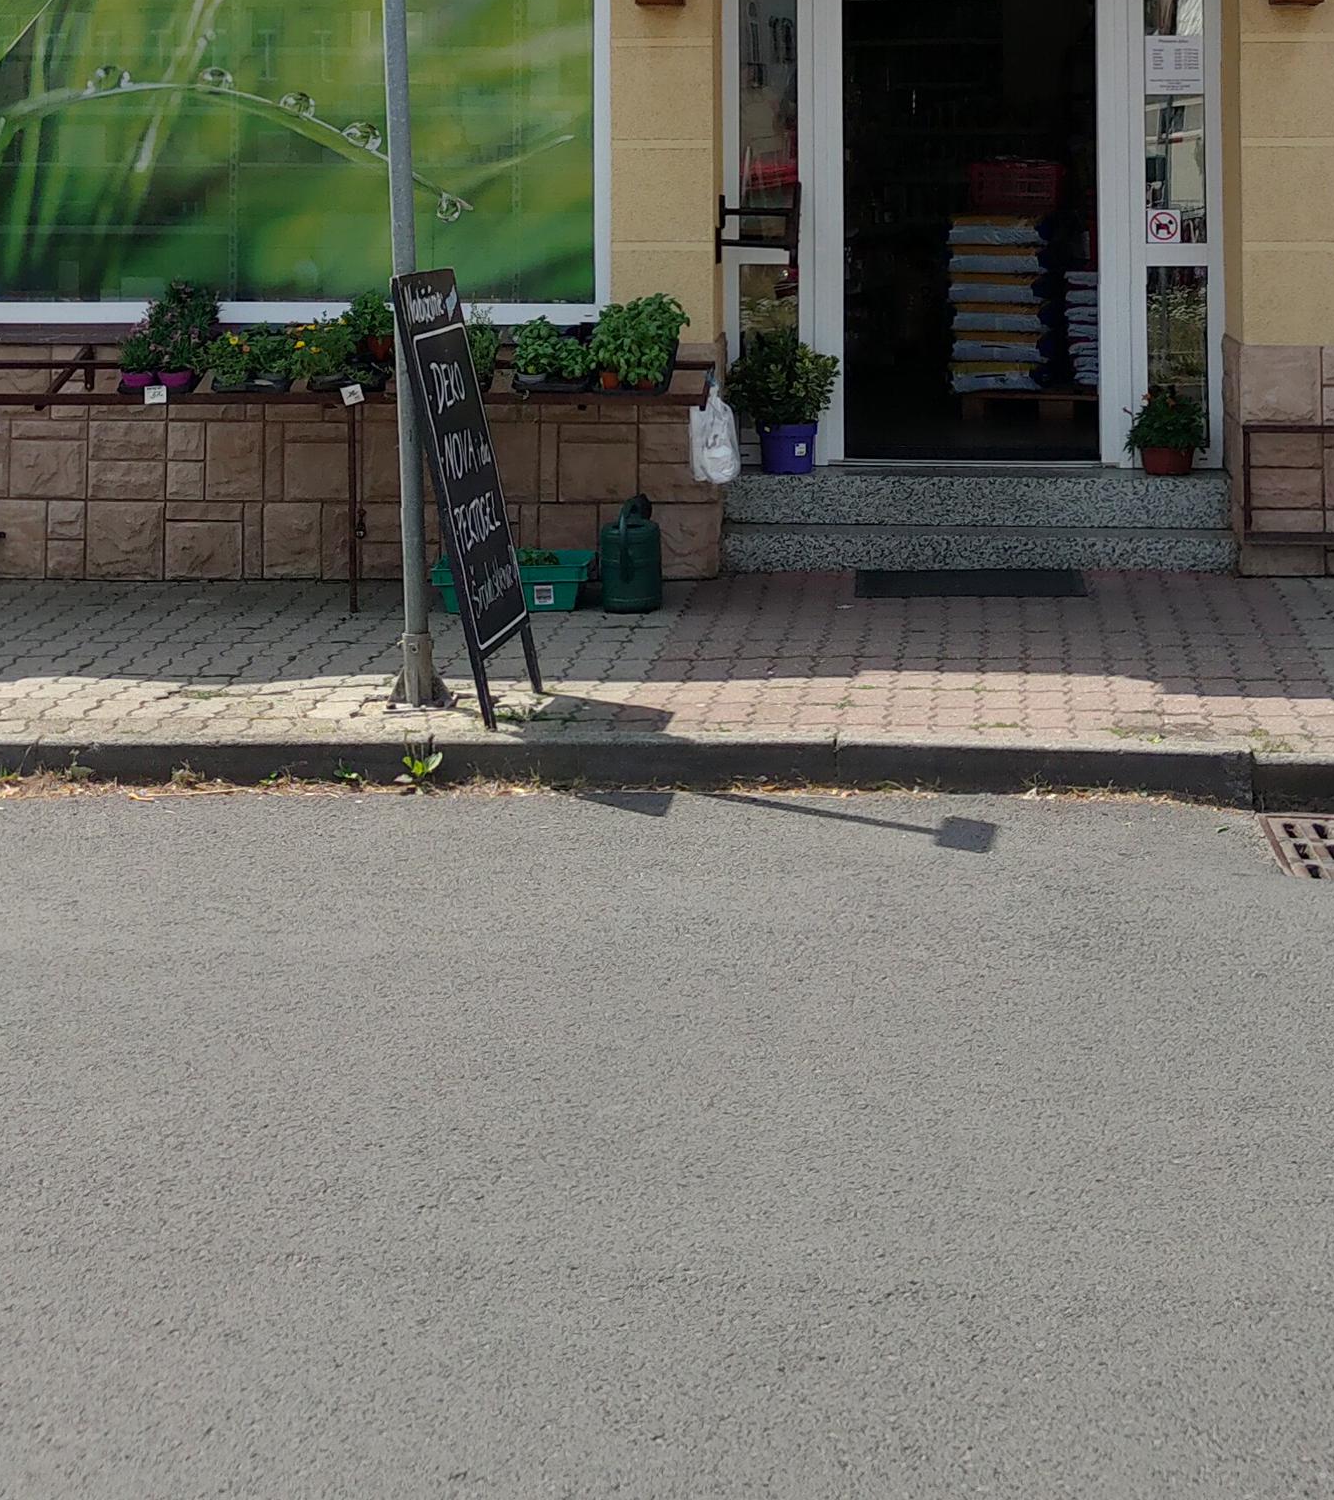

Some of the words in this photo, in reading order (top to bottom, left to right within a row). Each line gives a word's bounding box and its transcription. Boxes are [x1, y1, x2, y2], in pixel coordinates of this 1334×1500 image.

[430, 361, 466, 414] DEKO
[444, 428, 479, 480] NOVA
[454, 491, 501, 554] PEKTOGEL
